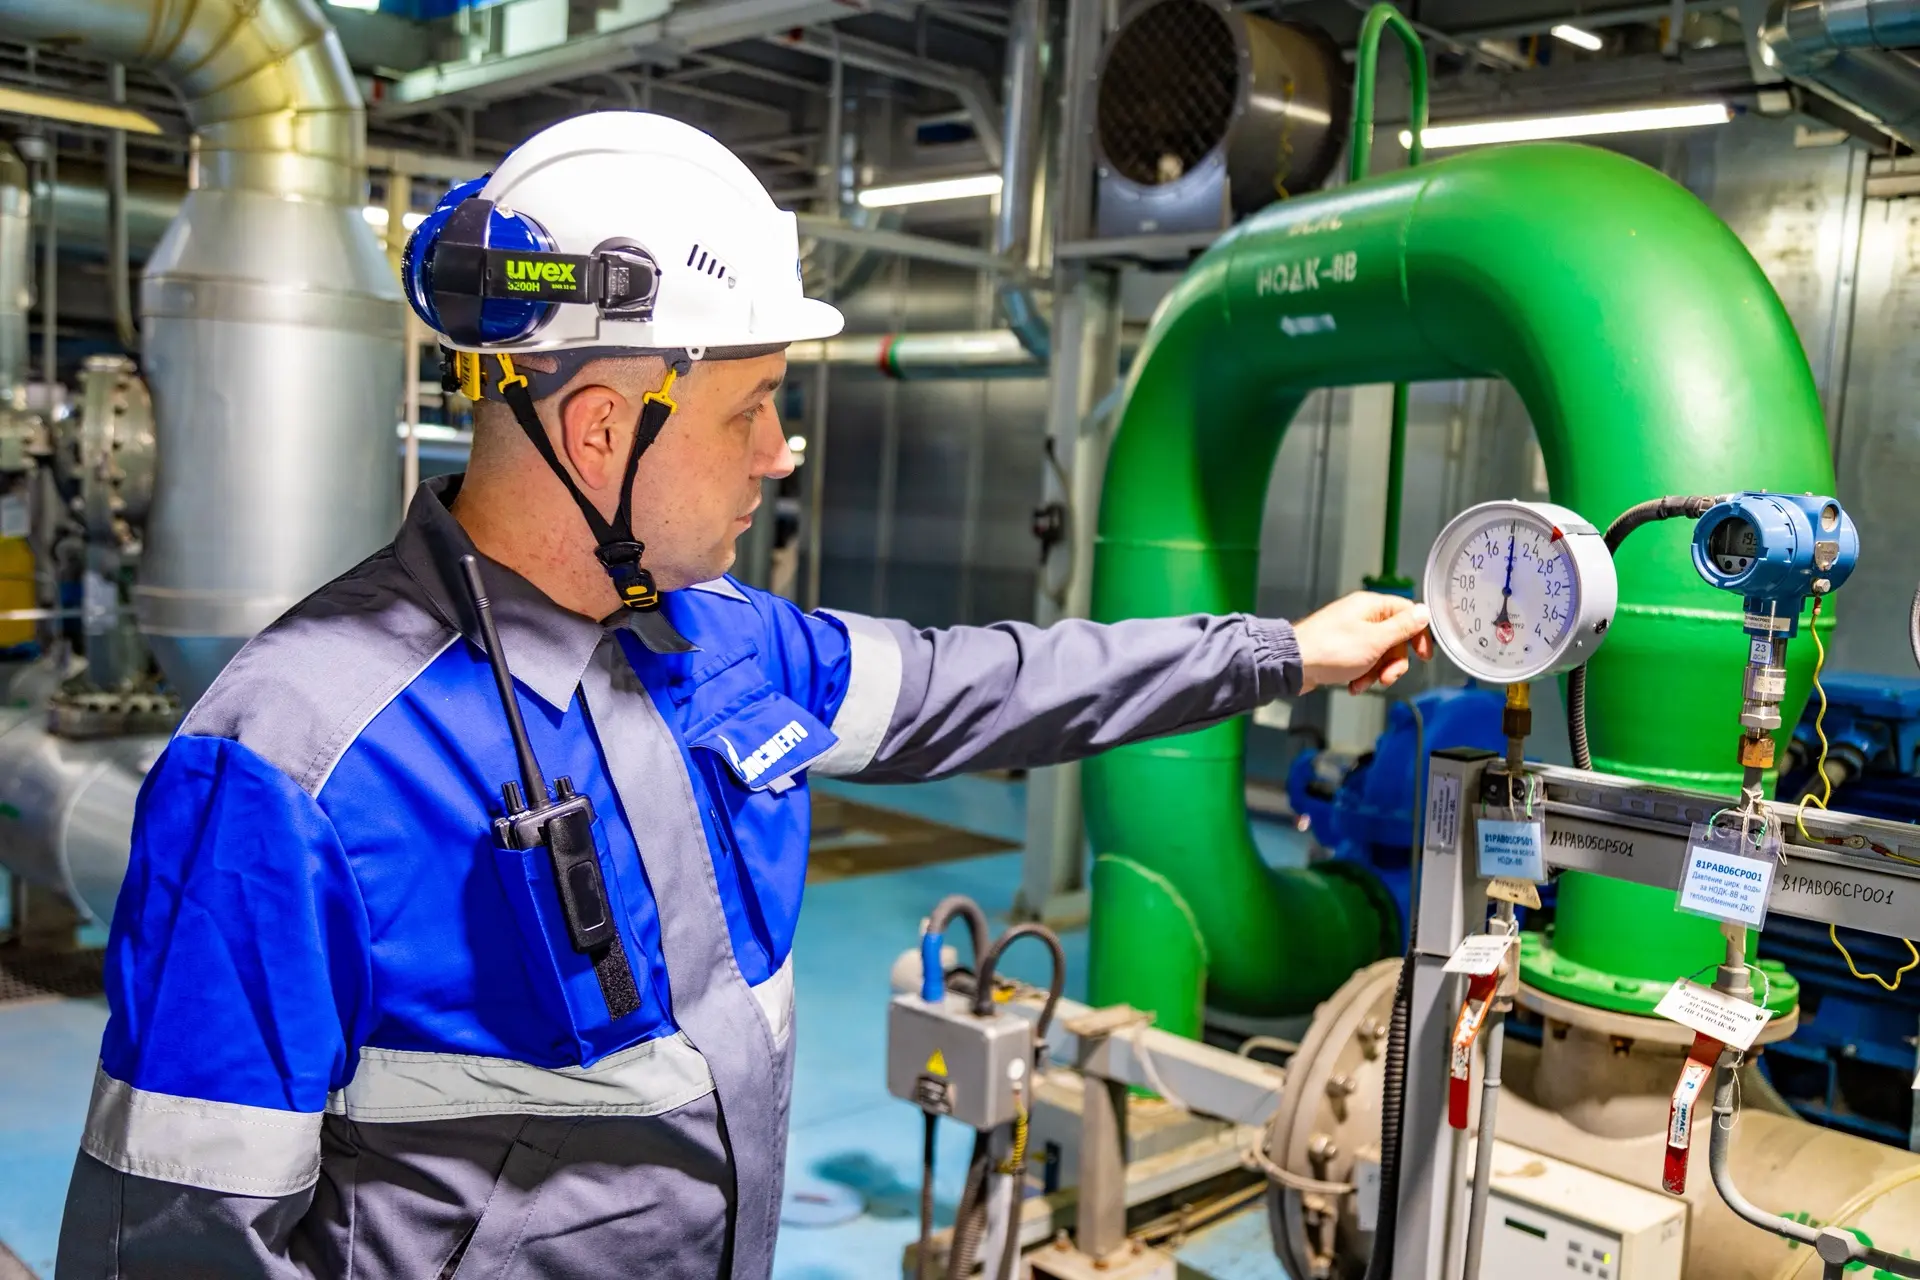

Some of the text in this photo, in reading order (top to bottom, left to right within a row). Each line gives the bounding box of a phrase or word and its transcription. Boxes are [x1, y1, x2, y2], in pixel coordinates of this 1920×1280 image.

[506, 260, 576, 283] uvex
[1485, 541, 1500, 558] 1,6
[1523, 543, 1540, 561] 2,4
[1470, 555, 1485, 572] 1,2
[1537, 559, 1554, 577] 2,8
[1459, 575, 1476, 592] 0,8
[1545, 581, 1561, 598] 3,2
[1460, 598, 1476, 613] 0,4
[1542, 604, 1559, 622] 3,6
[1474, 618, 1482, 632] 0
[1535, 623, 1542, 638] 4
[1754, 643, 1767, 653] 23
[1691, 871, 1723, 884] Давление
[1695, 859, 1762, 882] 81PAB06CP001
[1781, 873, 1895, 905] 81PAB06CP001
[1689, 892, 1756, 914] теплообменник ДКС
